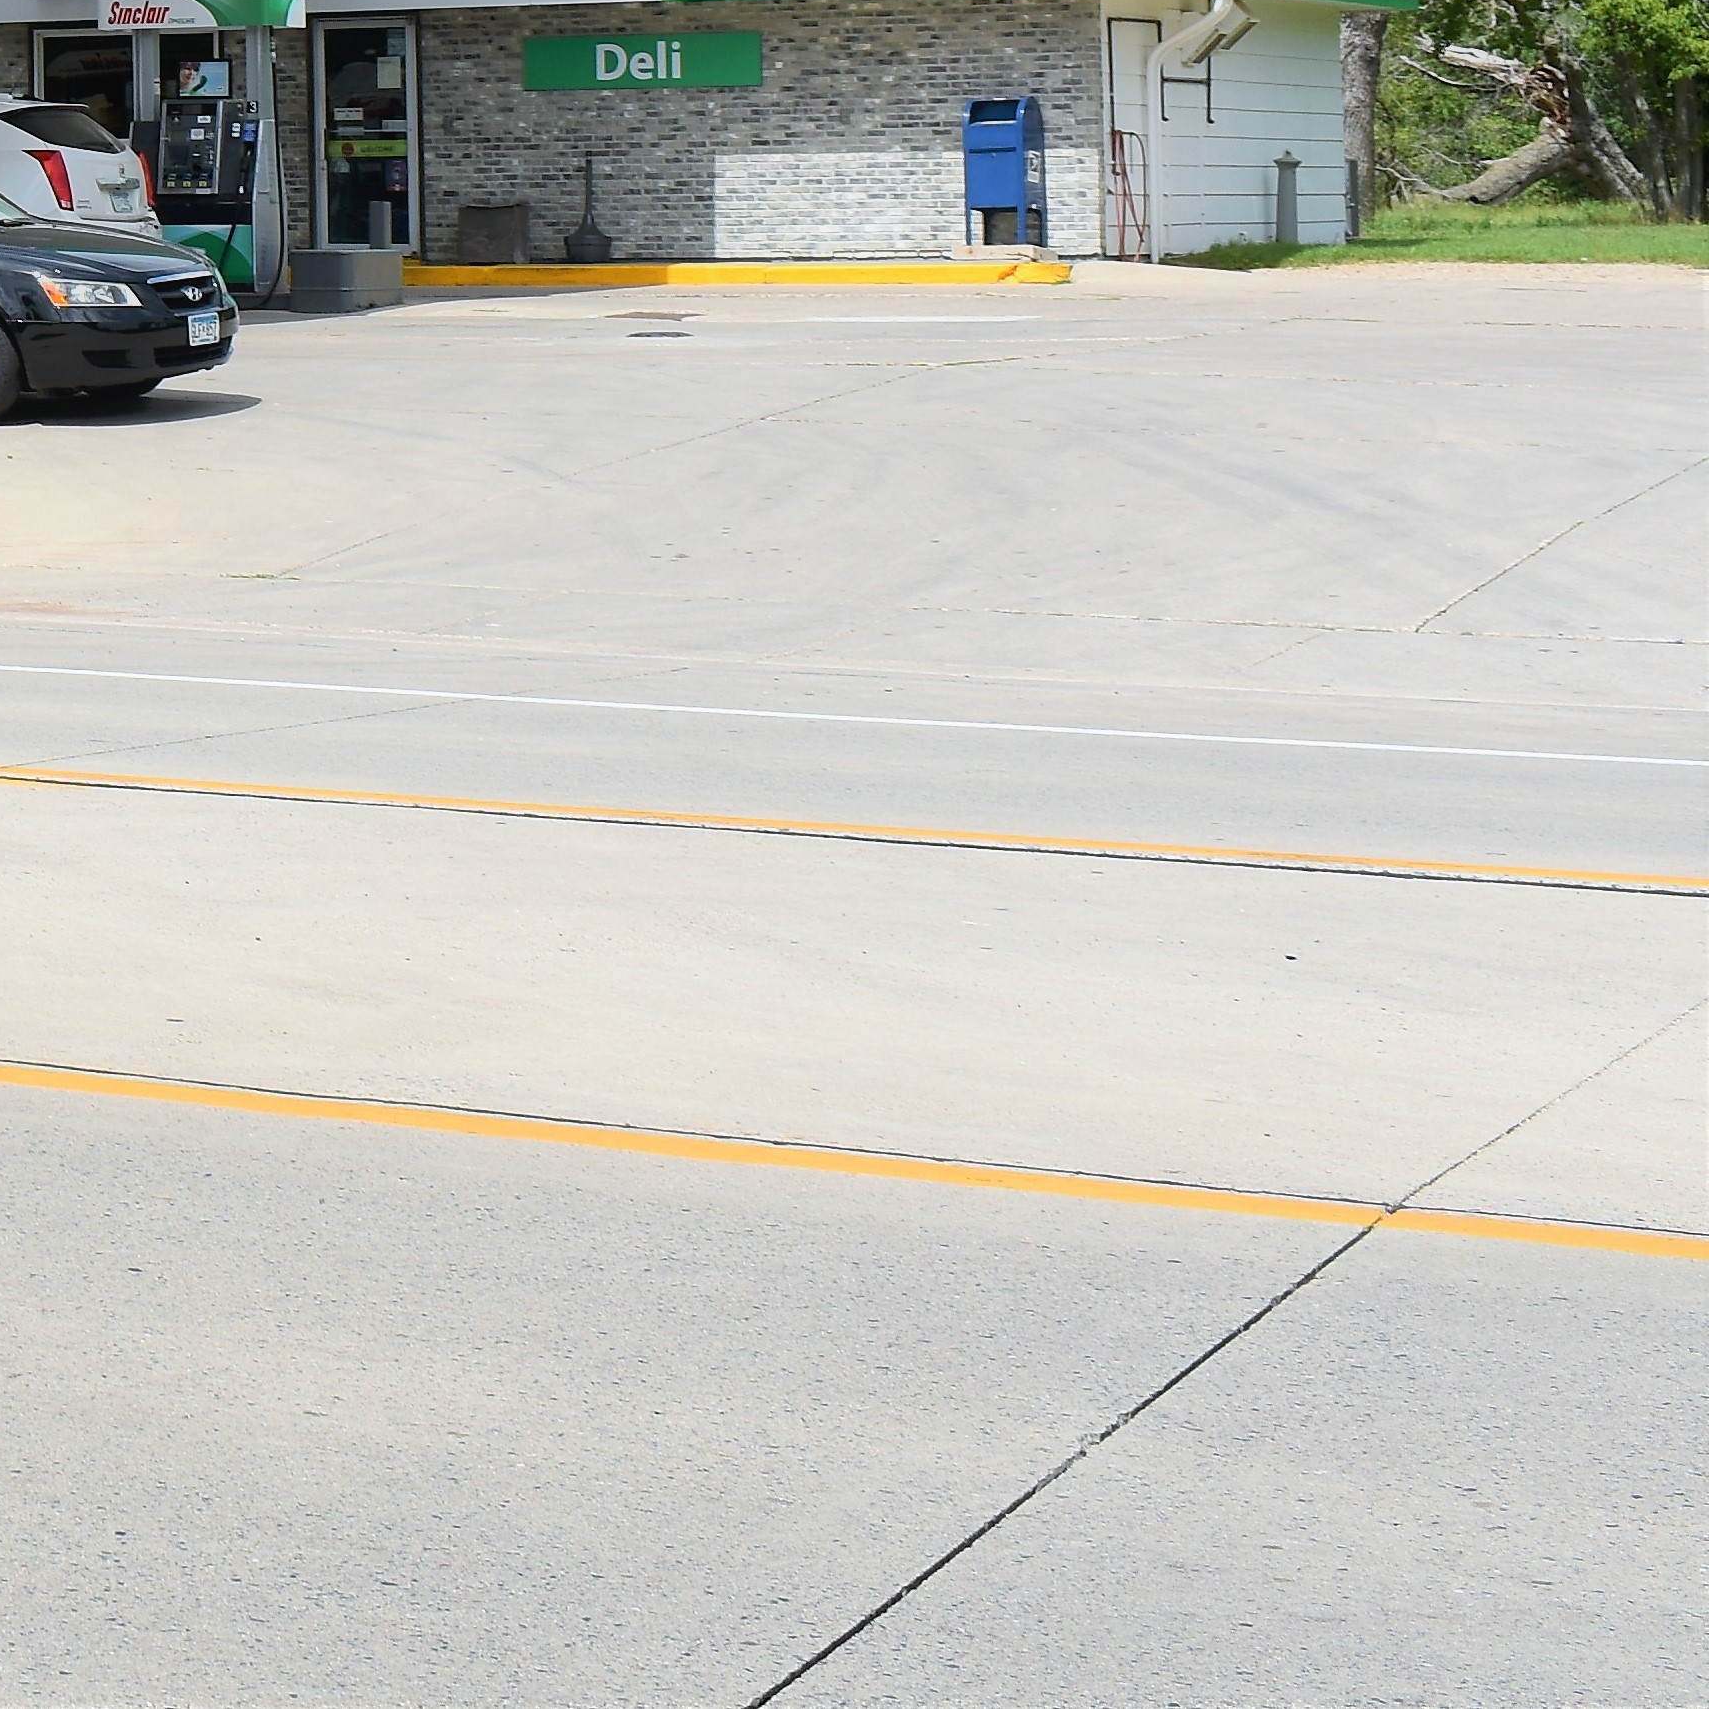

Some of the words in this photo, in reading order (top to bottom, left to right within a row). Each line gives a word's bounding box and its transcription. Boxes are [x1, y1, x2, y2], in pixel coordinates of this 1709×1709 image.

[107, 1, 171, 25] Sinclair
[595, 41, 681, 81] Deli
[249, 101, 257, 113] 3
